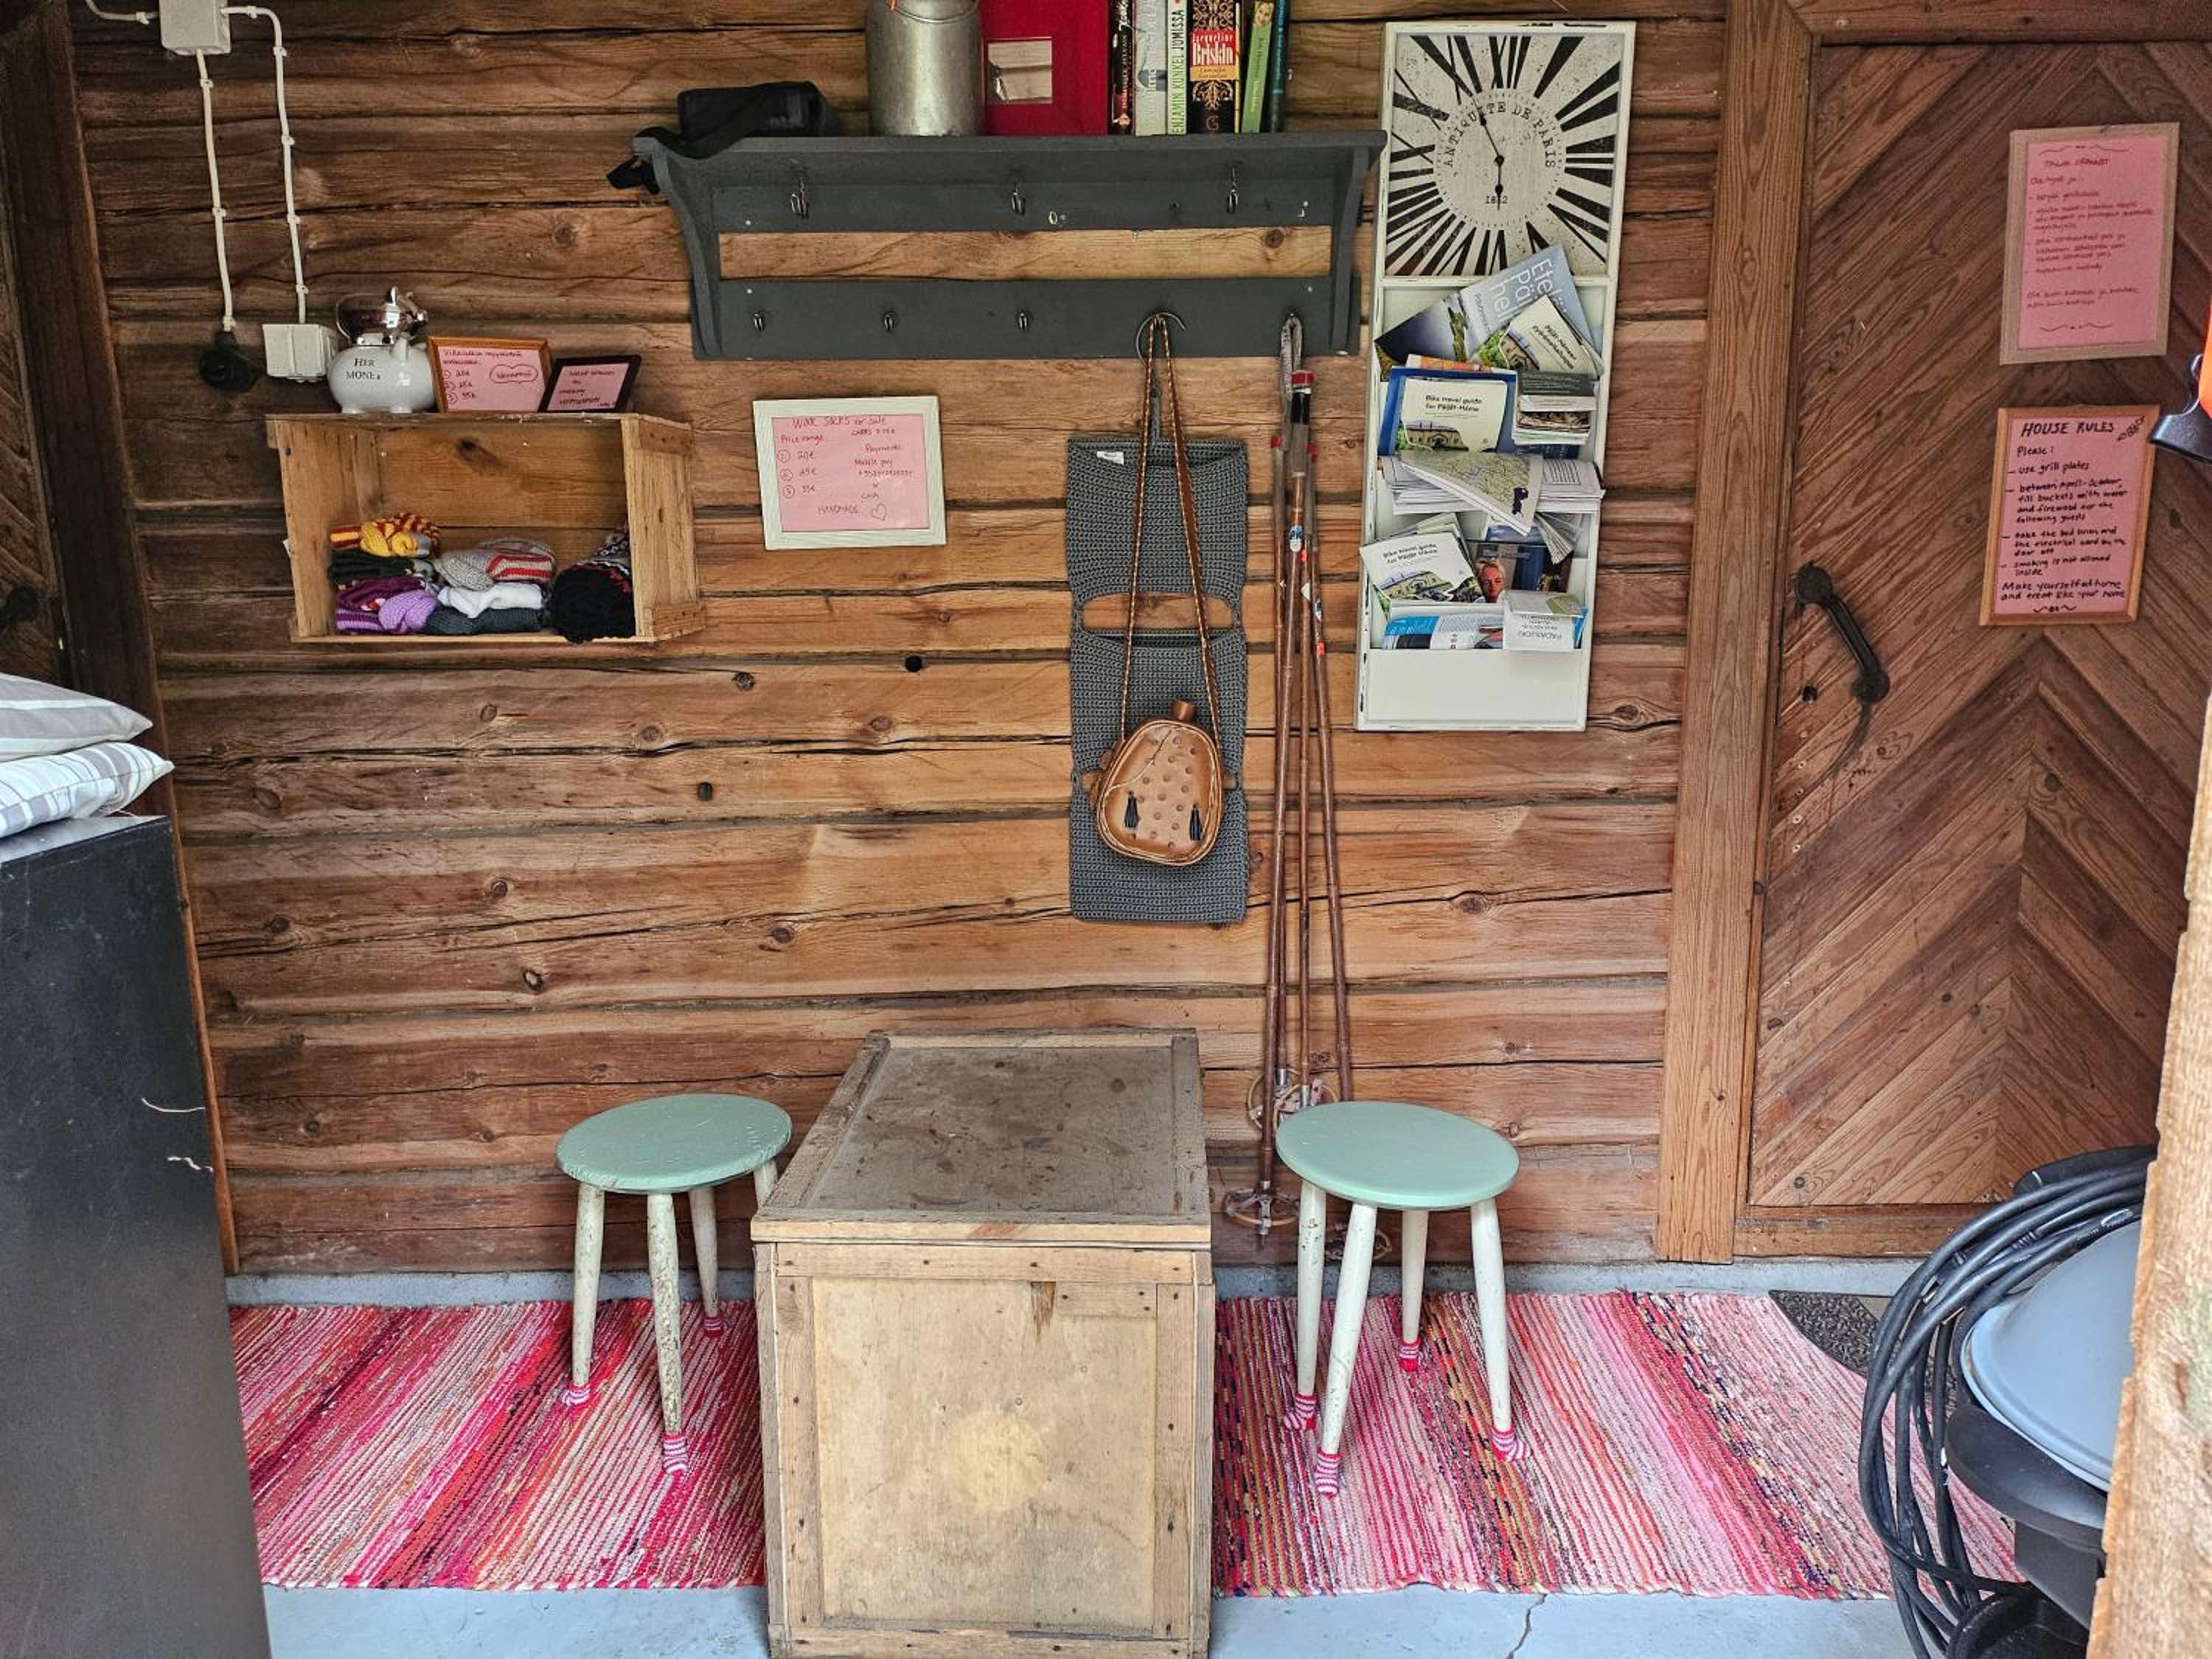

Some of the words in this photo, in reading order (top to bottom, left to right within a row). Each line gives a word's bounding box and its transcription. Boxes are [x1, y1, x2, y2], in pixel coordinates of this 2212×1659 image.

[1192, 42, 1234, 66] Briskin
[1172, 55, 1185, 89] KUNKEL
[1512, 105, 1532, 120] DE
[1534, 118, 1557, 168] PARIS
[2021, 422, 2070, 437] HOUSE
[2076, 422, 2115, 434] RULES
[2018, 466, 2035, 474] use
[2039, 462, 2059, 475] grill
[2062, 462, 2090, 475] plates
[2017, 493, 2033, 502] fill
[2037, 492, 2074, 503] buckets
[2017, 505, 2035, 514] and
[2037, 503, 2077, 513] firewood
[2017, 515, 2057, 524] following
[2060, 514, 2086, 524] guests
[2101, 526, 2117, 535] and
[2014, 560, 2049, 569] smoking
[2062, 556, 2079, 564] not
[2080, 554, 2112, 563] allowed
[2015, 568, 2043, 577] inside
[2002, 582, 2033, 591] Make
[2095, 579, 2121, 589] home
[2000, 593, 2021, 601] and
[2102, 590, 2125, 599] home
